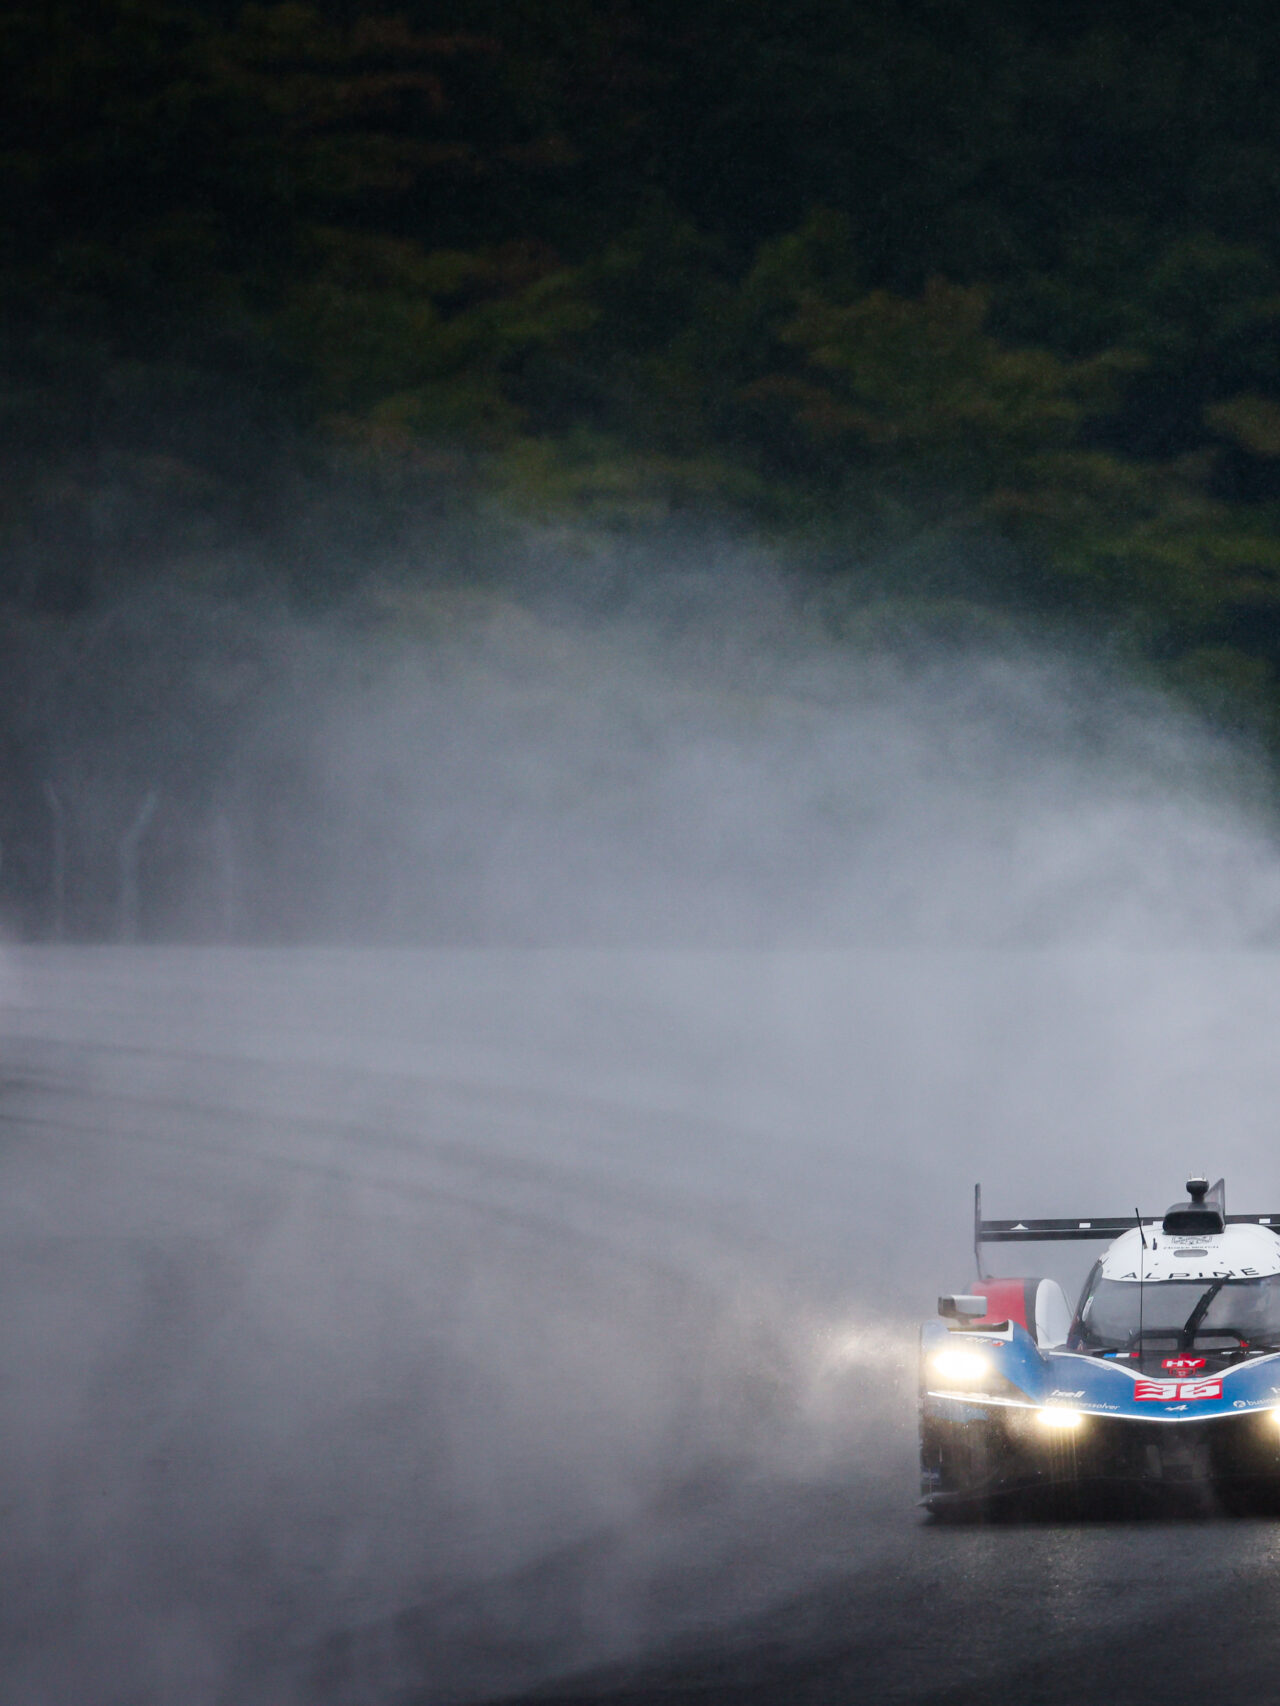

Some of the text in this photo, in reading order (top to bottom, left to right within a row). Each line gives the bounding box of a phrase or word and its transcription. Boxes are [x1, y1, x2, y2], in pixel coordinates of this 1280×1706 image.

[1120, 1267, 1260, 1279] ALPINE
[1166, 1359, 1202, 1368] HY
[1135, 1379, 1221, 1399] 36
